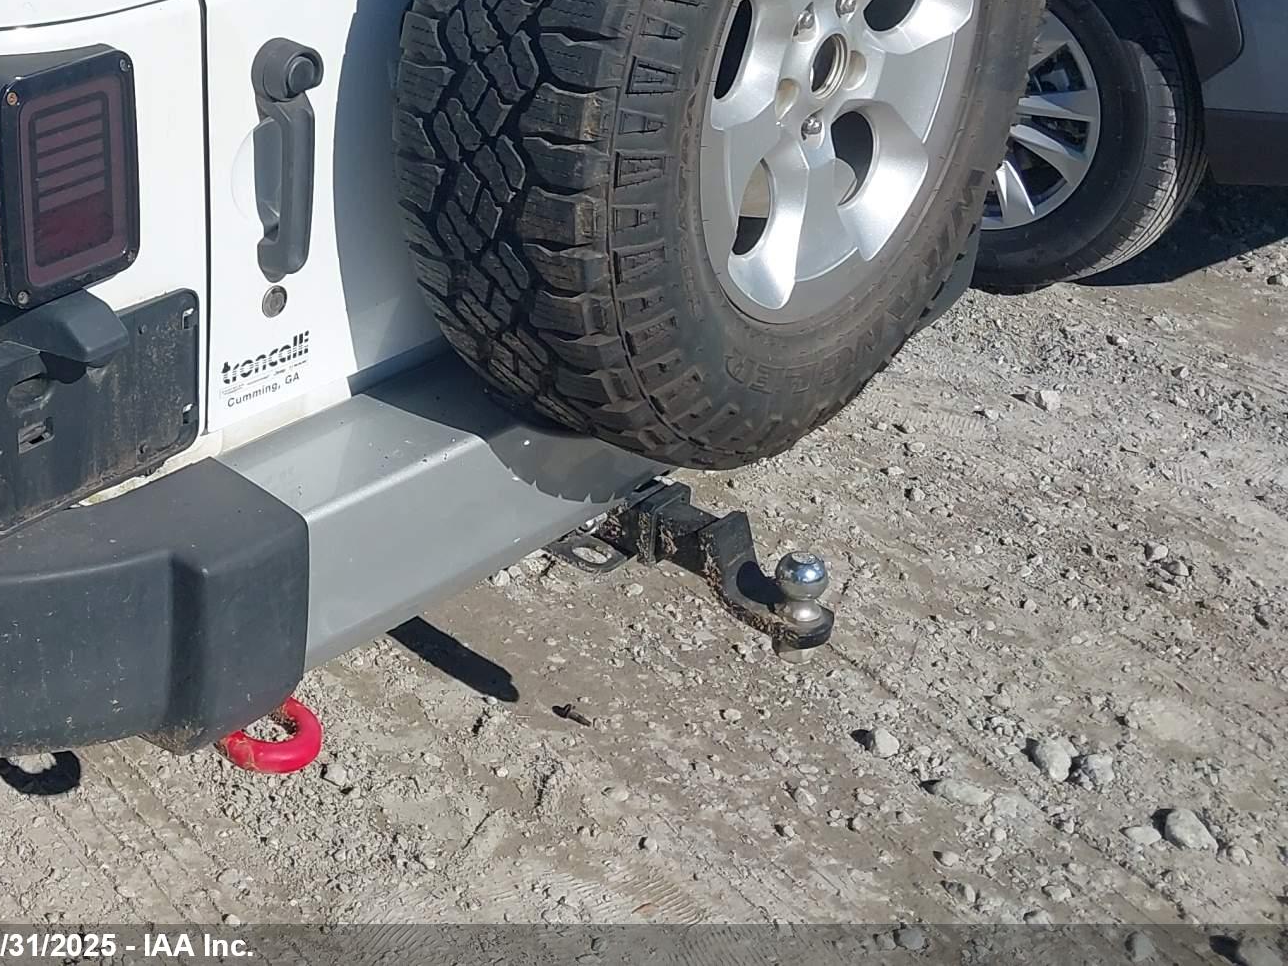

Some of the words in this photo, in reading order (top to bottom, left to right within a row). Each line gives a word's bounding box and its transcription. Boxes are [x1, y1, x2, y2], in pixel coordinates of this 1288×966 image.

[221, 330, 309, 384] troncalli
[227, 382, 281, 408] Cumming,
[284, 372, 300, 385] GA
